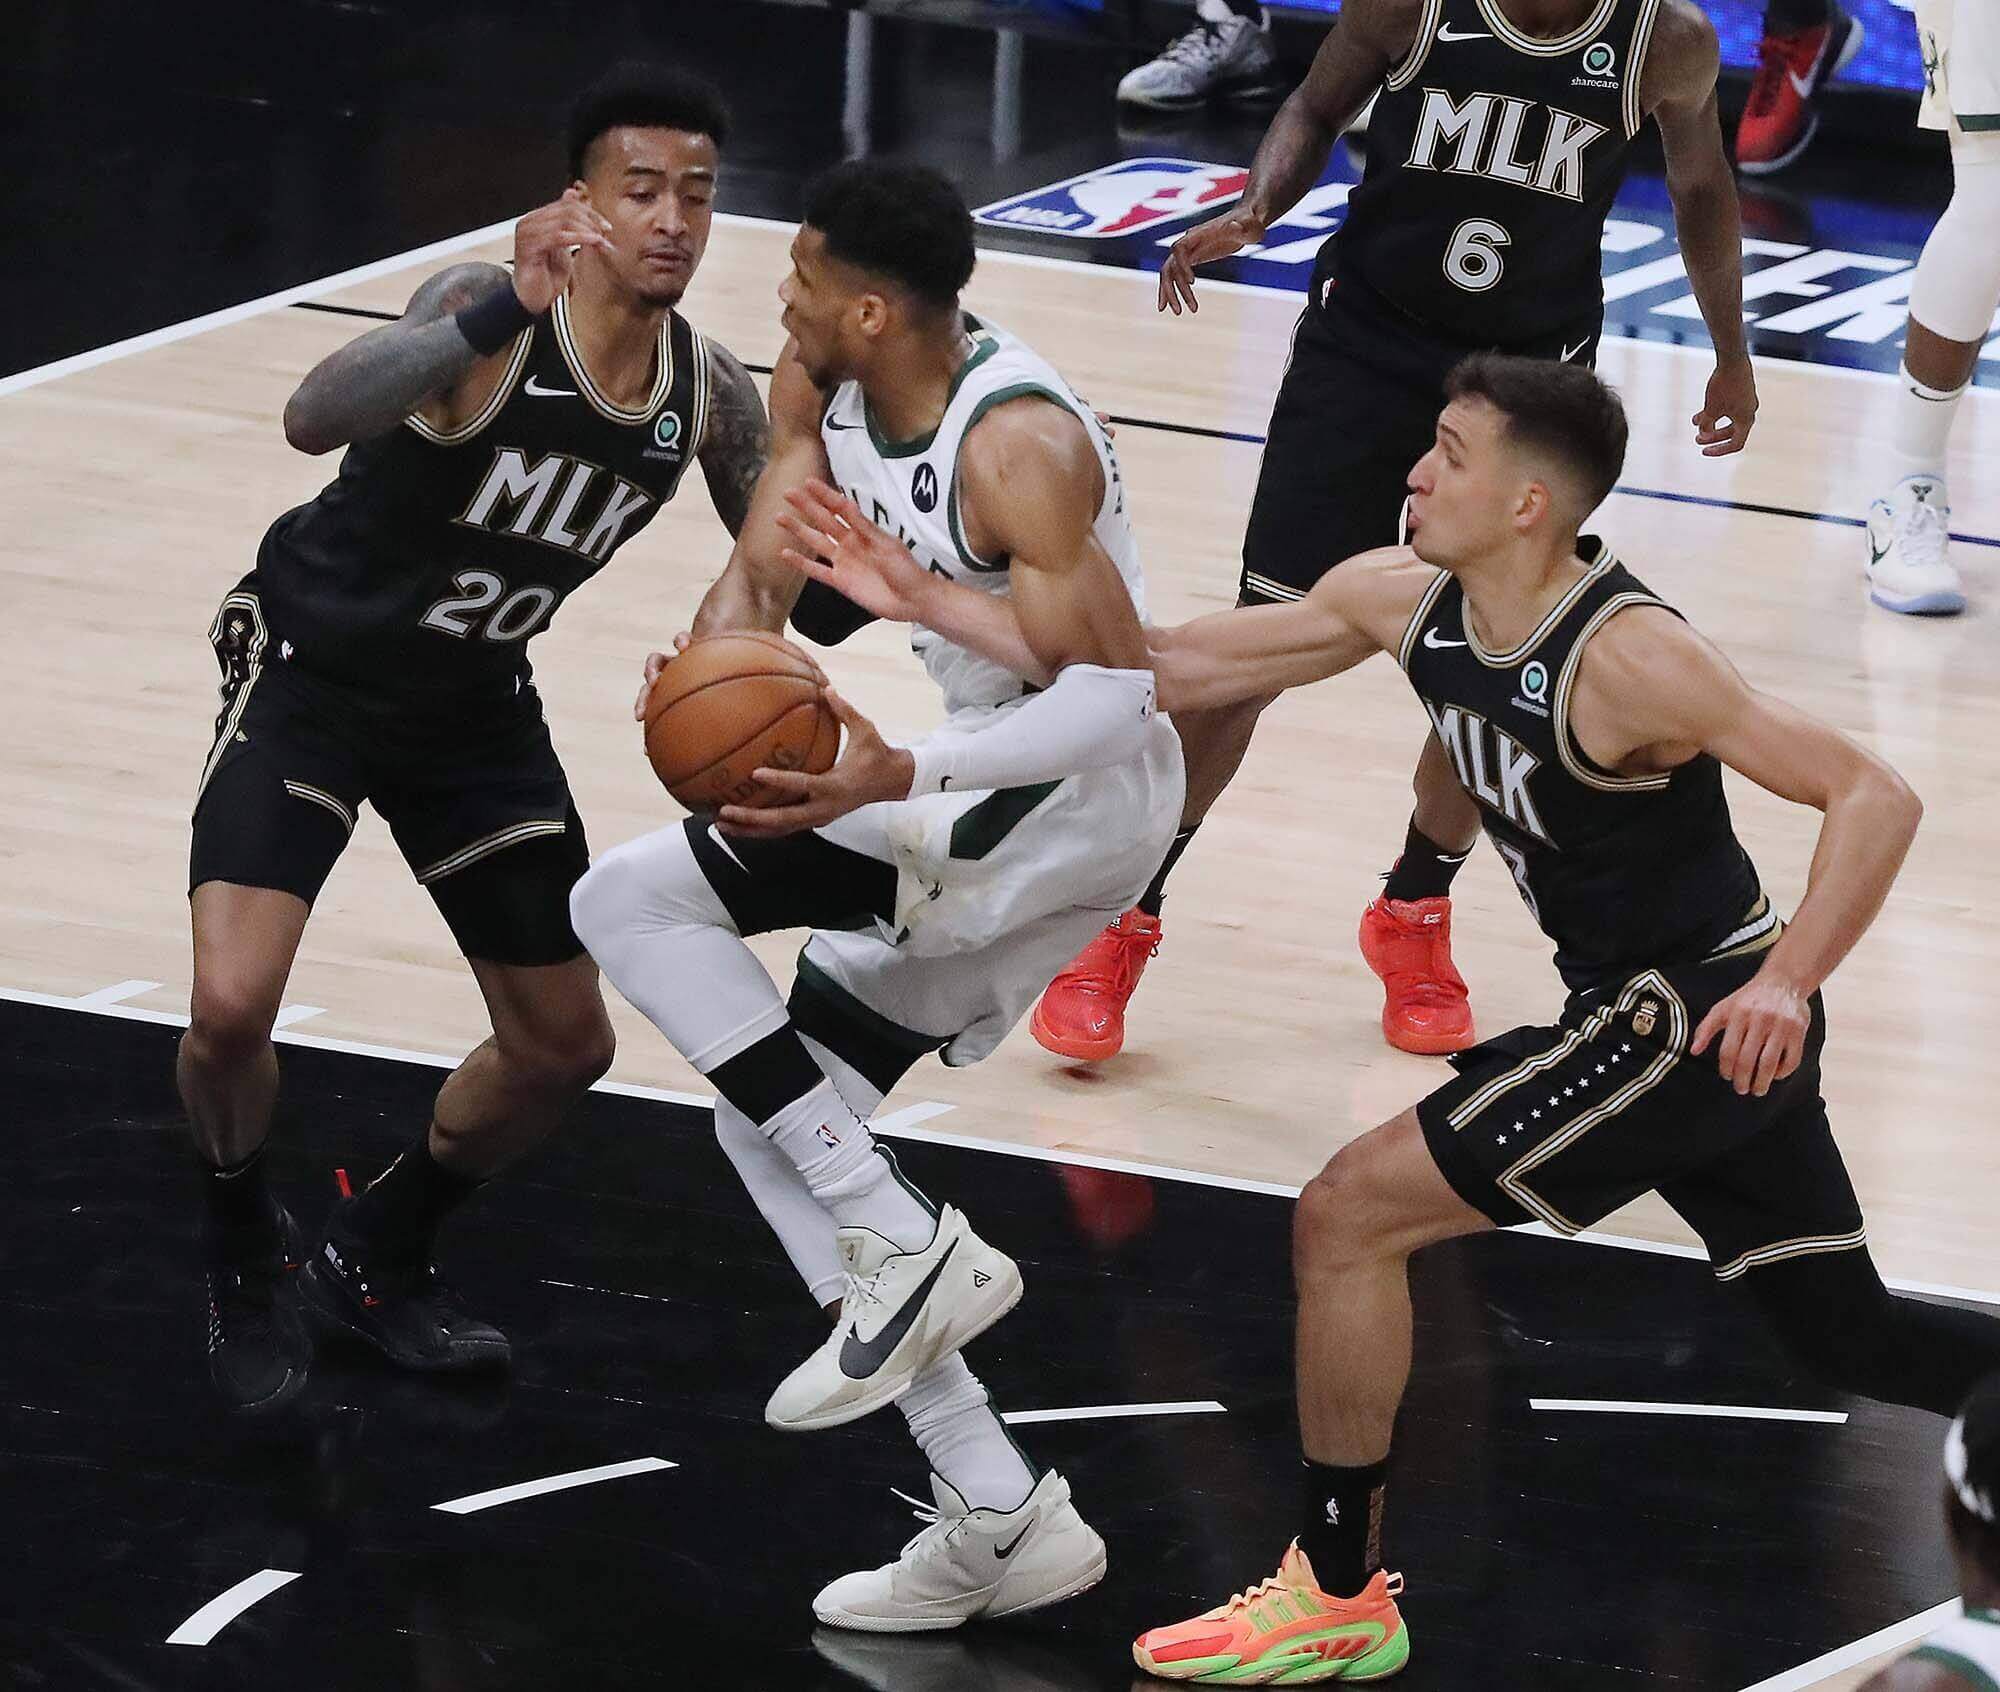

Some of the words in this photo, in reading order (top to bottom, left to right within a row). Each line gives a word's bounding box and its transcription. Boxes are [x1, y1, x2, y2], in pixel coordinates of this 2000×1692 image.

[1570, 76, 1619, 89] sharecare
[1403, 87, 1610, 202] MLK
[1443, 217, 1511, 292] 6
[451, 447, 656, 563] MLK
[418, 568, 558, 641] 20
